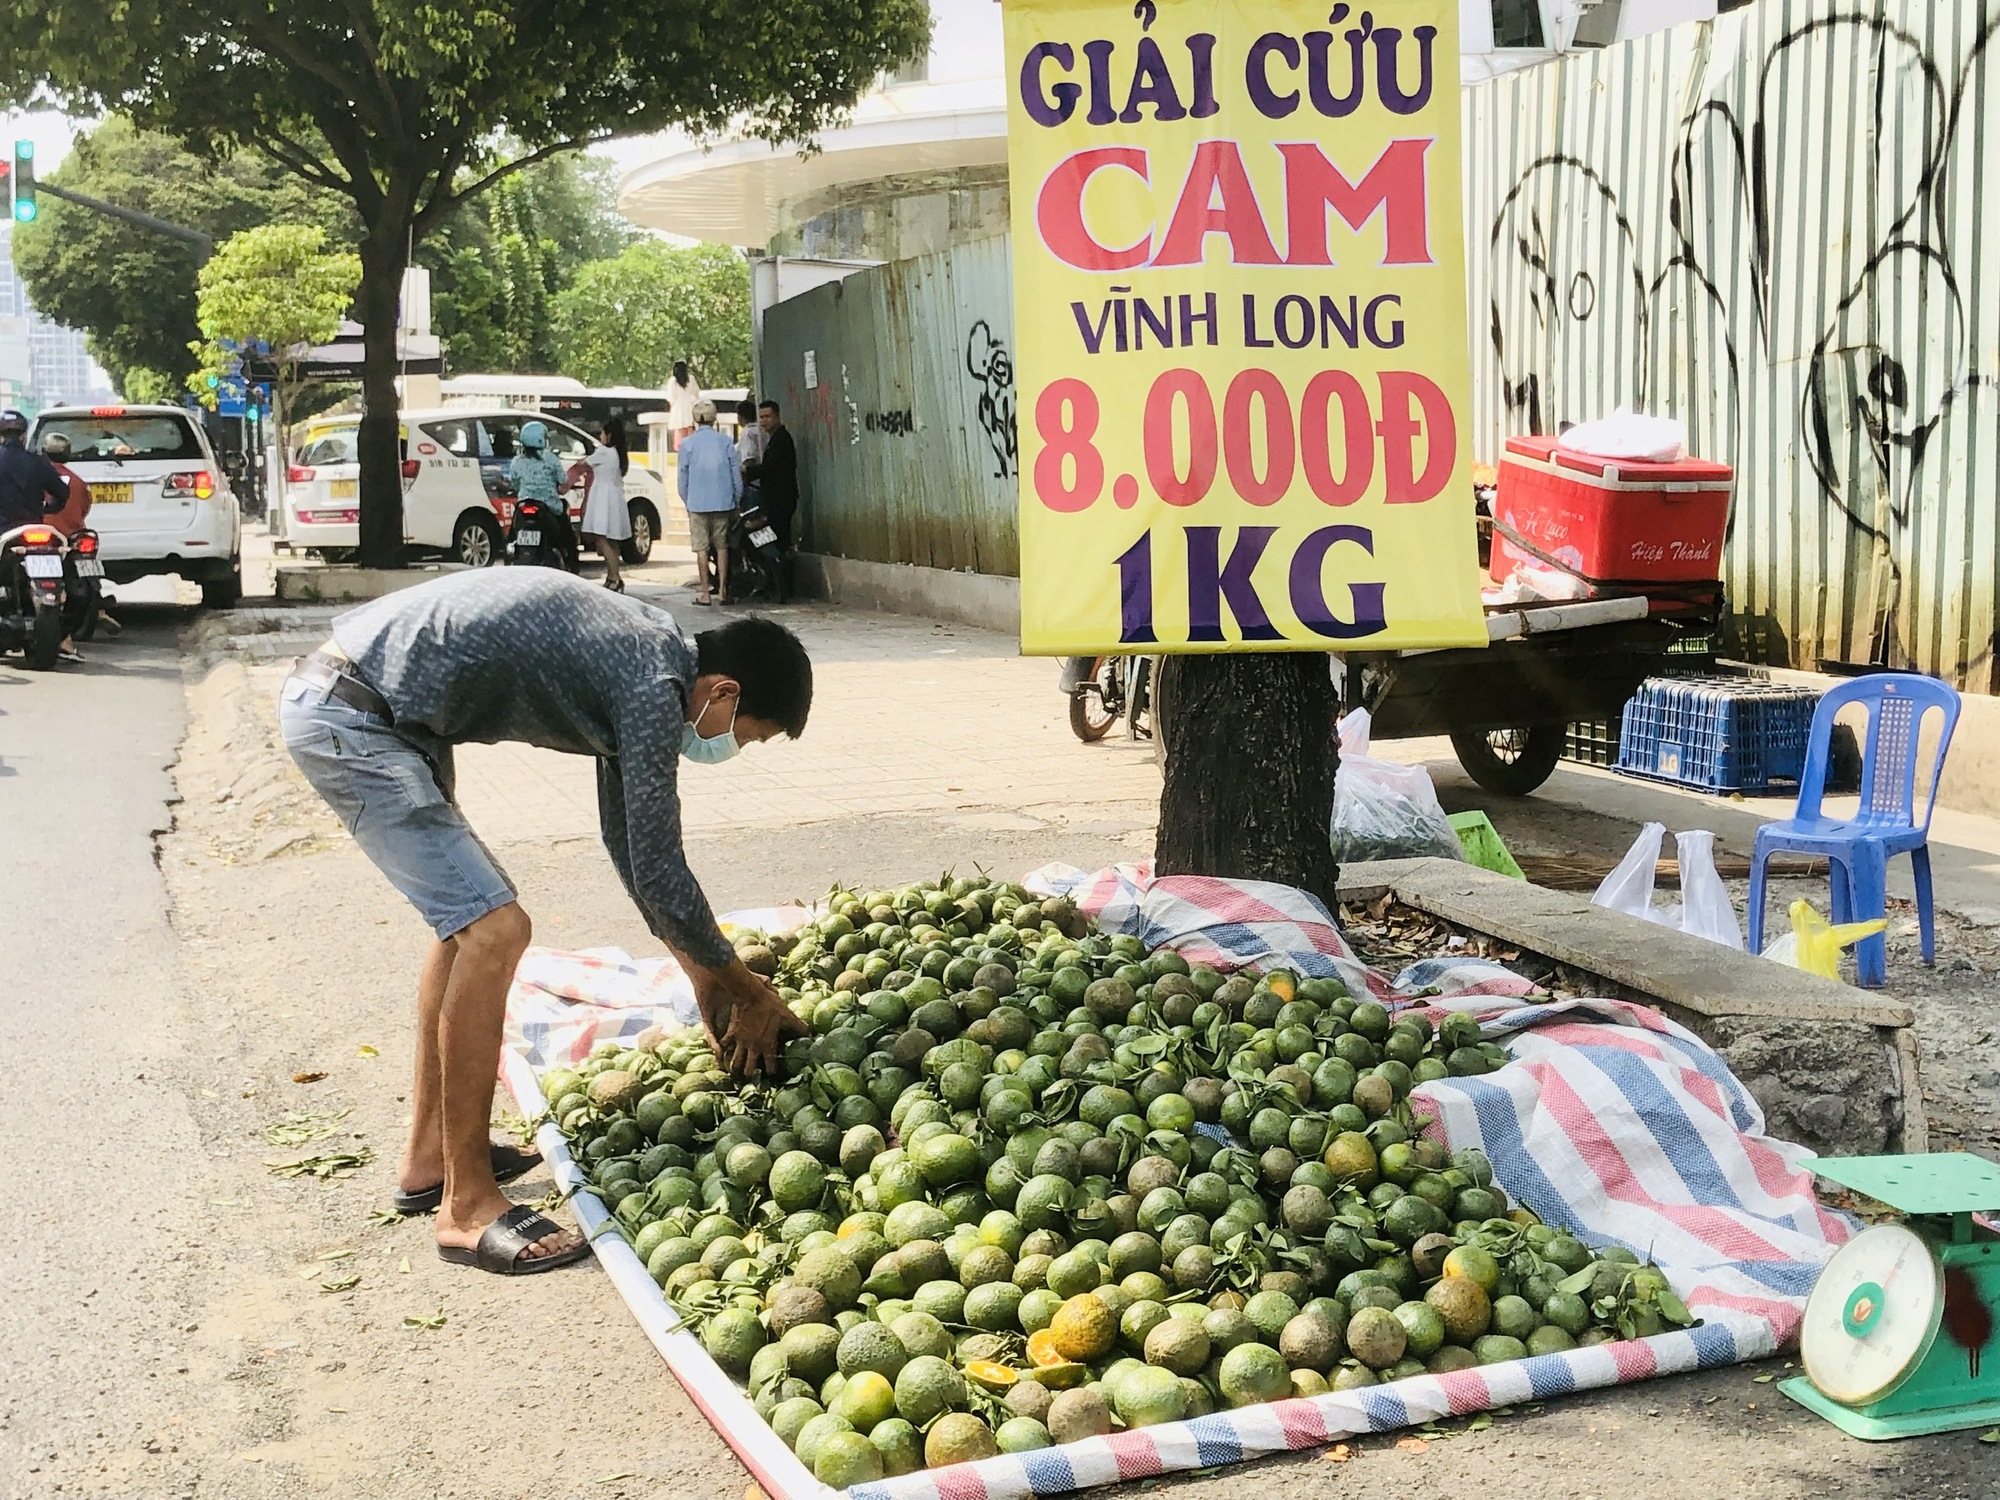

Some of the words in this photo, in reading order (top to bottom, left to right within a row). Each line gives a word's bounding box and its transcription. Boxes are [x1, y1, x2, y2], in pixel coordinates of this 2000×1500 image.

[1020, 0, 1220, 127] GIẢI
[1245, 2, 1438, 119] CỨU
[1036, 137, 1438, 272] CAM
[1071, 286, 1218, 353] VĨNH
[1243, 294, 1405, 349] LONG
[1034, 368, 1457, 513] 8.000Đ
[1630, 541, 1663, 565] Hiệp
[1670, 538, 1711, 561] Thành
